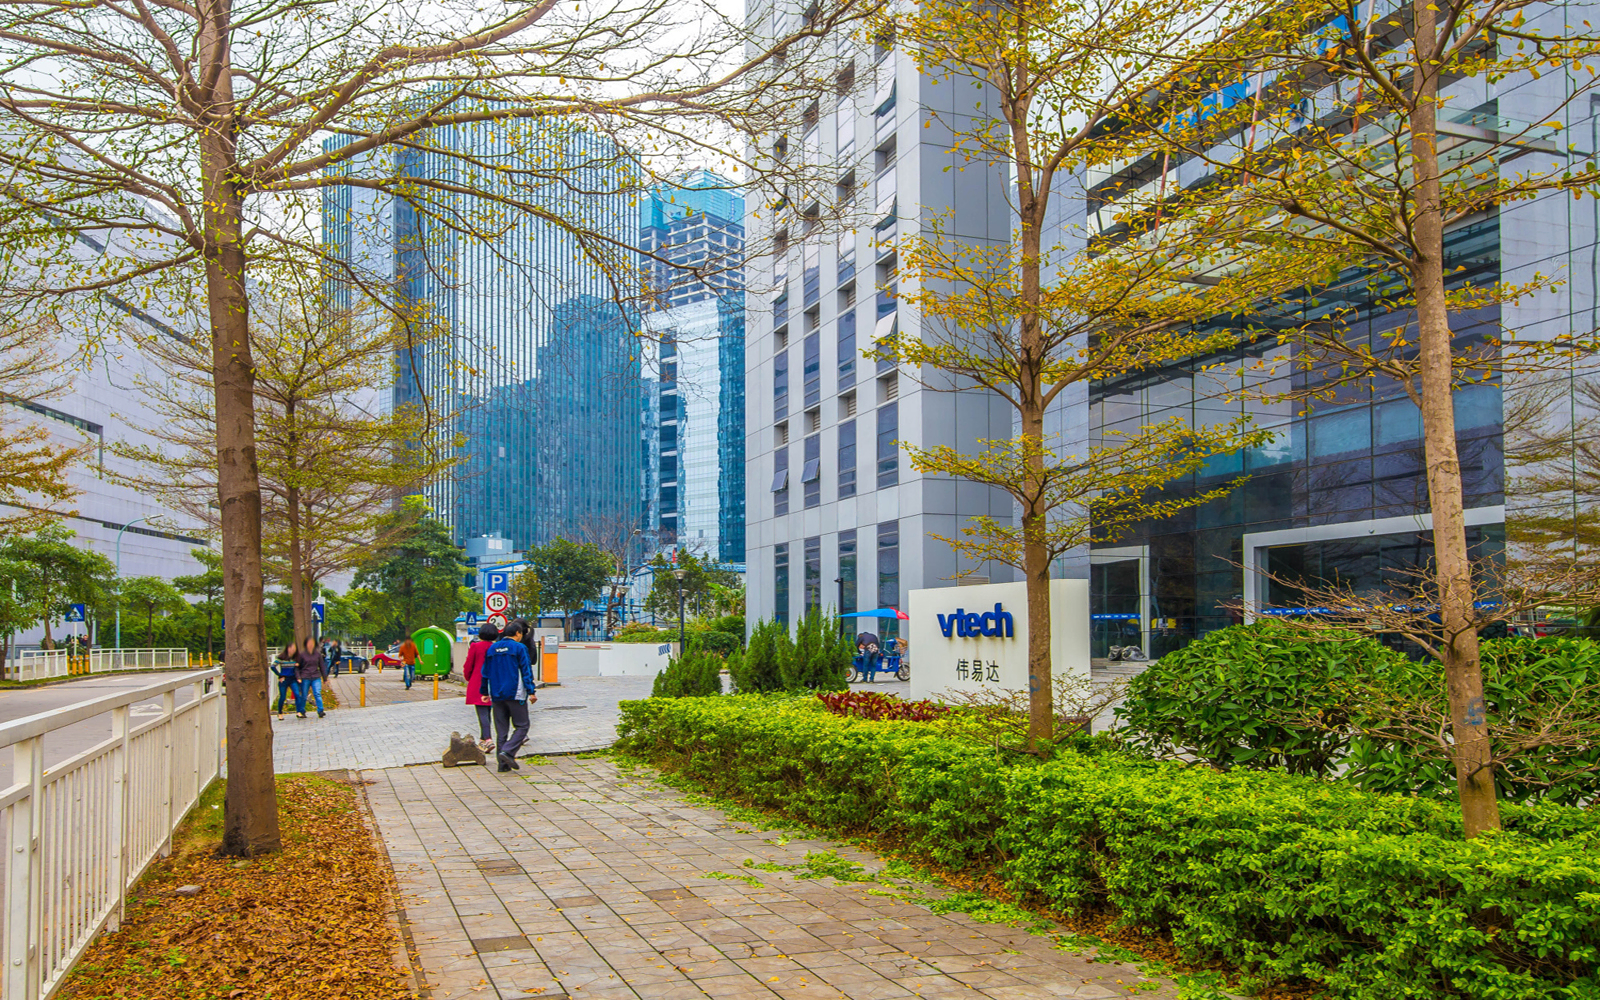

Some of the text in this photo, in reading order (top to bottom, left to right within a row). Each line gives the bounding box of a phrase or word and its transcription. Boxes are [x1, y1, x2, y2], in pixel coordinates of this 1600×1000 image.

[491, 575, 503, 589] P
[491, 597, 503, 607] 15
[936, 602, 1013, 637] vtech
[956, 659, 999, 682] 伟易达
